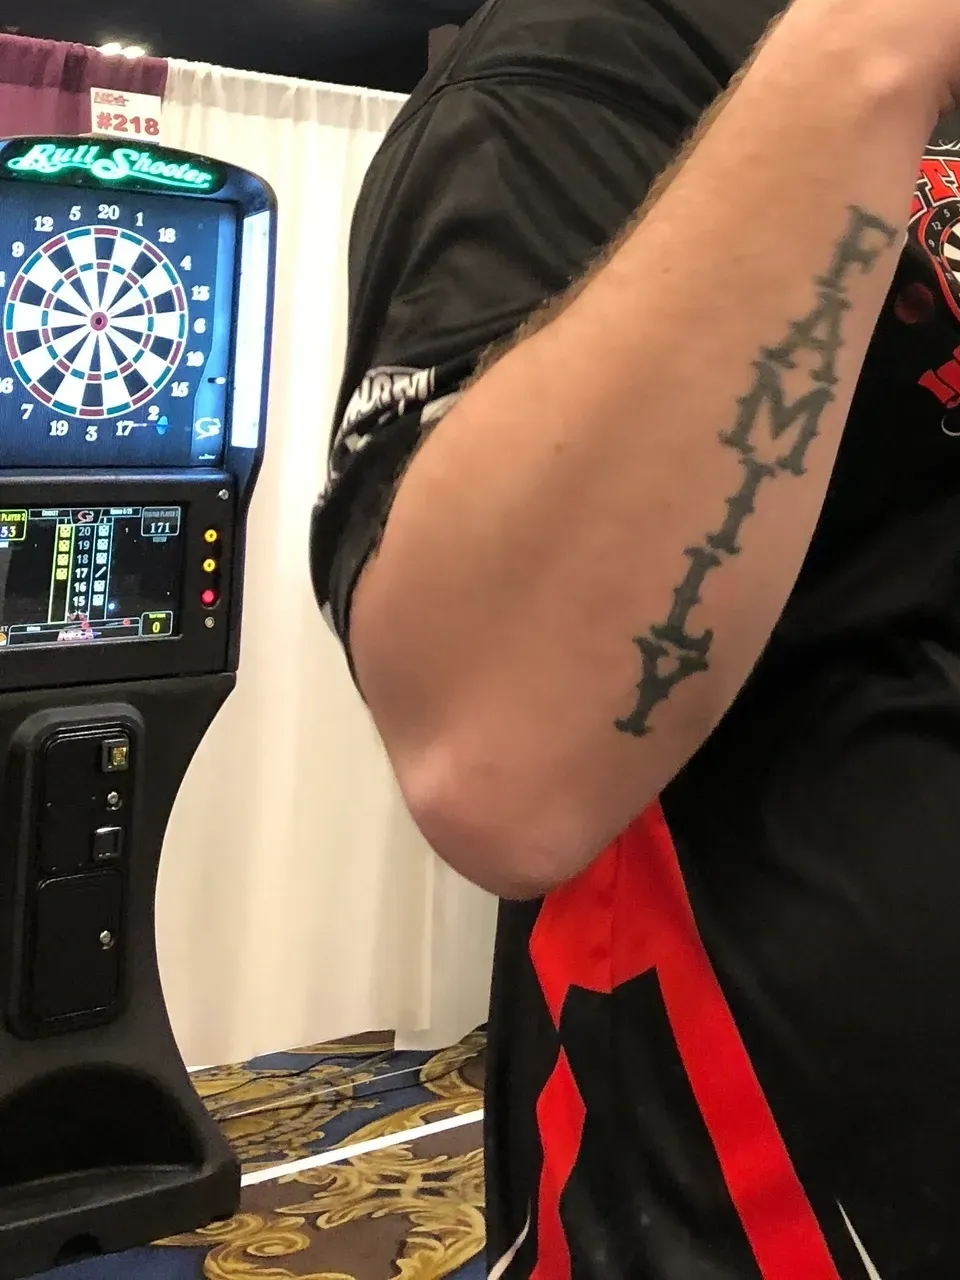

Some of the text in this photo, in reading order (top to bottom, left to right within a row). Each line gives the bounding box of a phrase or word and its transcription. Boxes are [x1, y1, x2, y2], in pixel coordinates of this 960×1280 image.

[96, 111, 160, 136] #218
[7, 143, 212, 188] Bull Shooter
[69, 206, 82, 220] 5
[98, 204, 120, 220] 20
[136, 212, 144, 227] 1
[34, 216, 54, 232] 12
[931, 221, 942, 231] 12
[158, 228, 176, 243] 18
[11, 242, 25, 257] 9
[180, 255, 192, 271] 4
[171, 382, 189, 397] 15
[21, 404, 34, 419] 7
[147, 405, 160, 420] 2
[50, 420, 69, 436] 19
[85, 426, 97, 441] 3
[116, 420, 134, 436] 17
[614, 204, 898, 738] FAMILY
[78, 526, 91, 536] 20
[150, 522, 170, 534] 171
[77, 540, 90, 550] 19
[77, 554, 89, 564] 18
[75, 568, 89, 579] 17
[74, 581, 87, 592] 16
[73, 595, 86, 607] 15
[152, 621, 160, 633] 0
